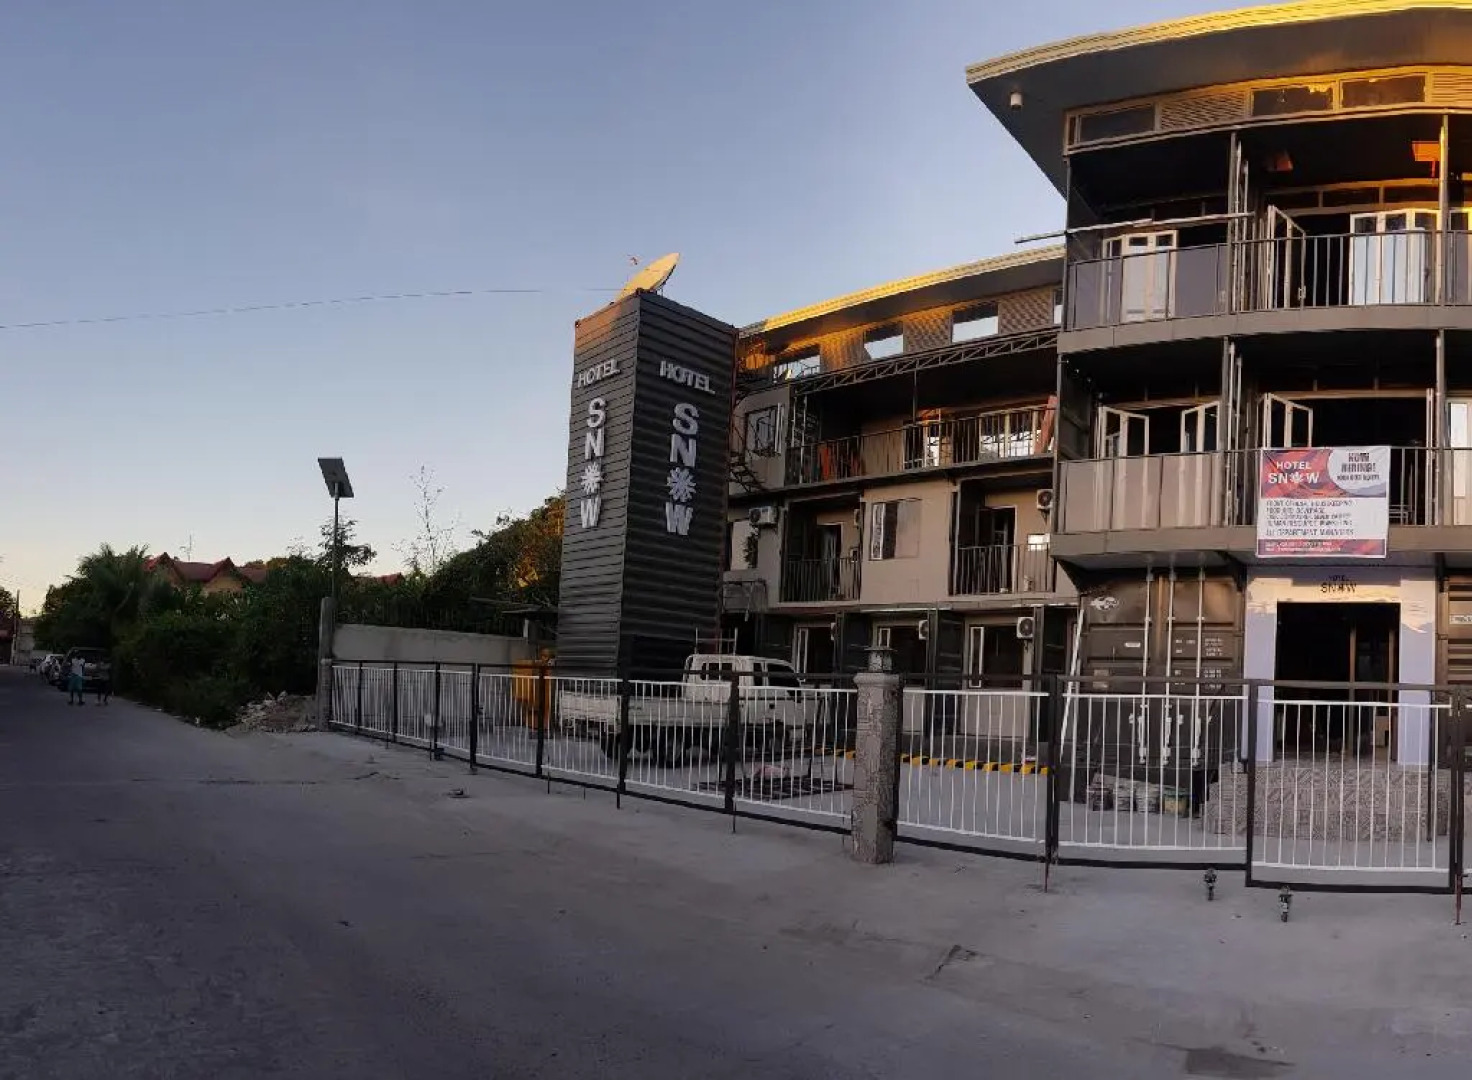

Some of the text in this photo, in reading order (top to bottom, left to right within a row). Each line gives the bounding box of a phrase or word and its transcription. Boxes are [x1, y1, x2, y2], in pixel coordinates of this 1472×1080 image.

[577, 359, 621, 388] HOTEL
[659, 360, 716, 395] HOTEL
[1276, 461, 1312, 470] HOTEL
